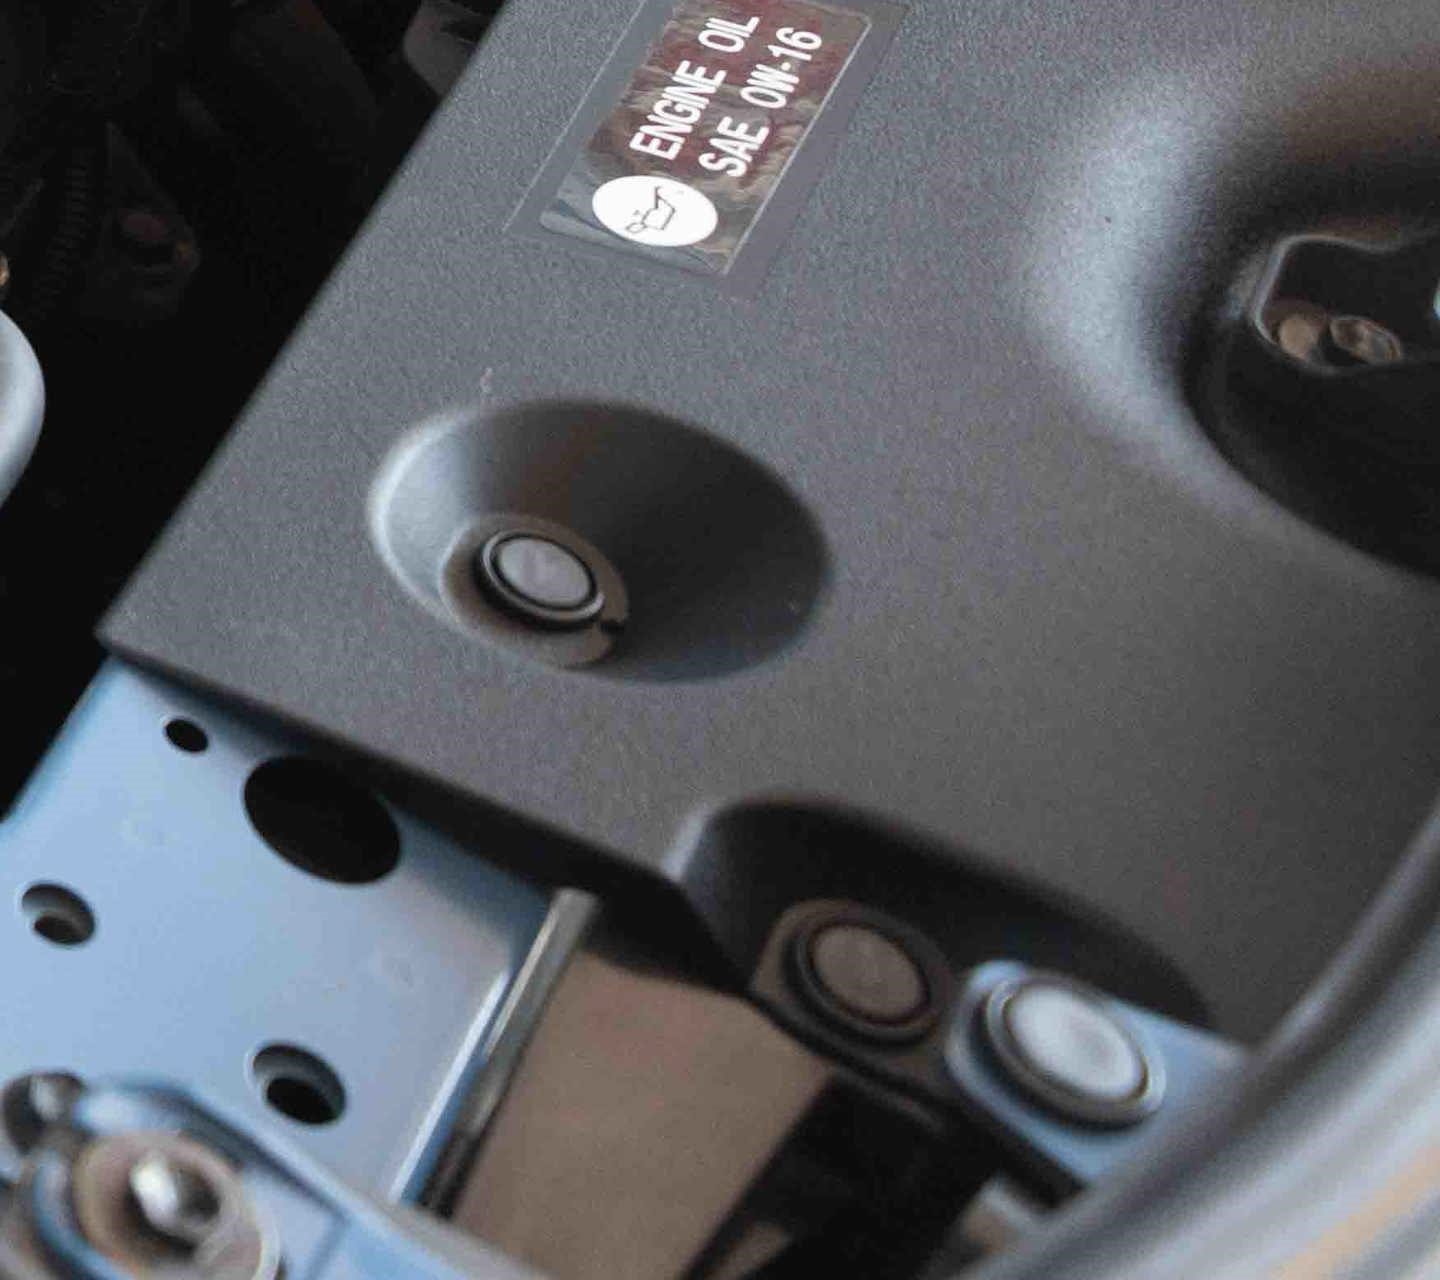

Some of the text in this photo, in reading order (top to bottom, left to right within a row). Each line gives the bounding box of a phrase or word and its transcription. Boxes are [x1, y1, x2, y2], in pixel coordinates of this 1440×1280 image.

[629, 16, 760, 160] ENGINE OIL
[698, 27, 822, 177] SAE 0W-16
